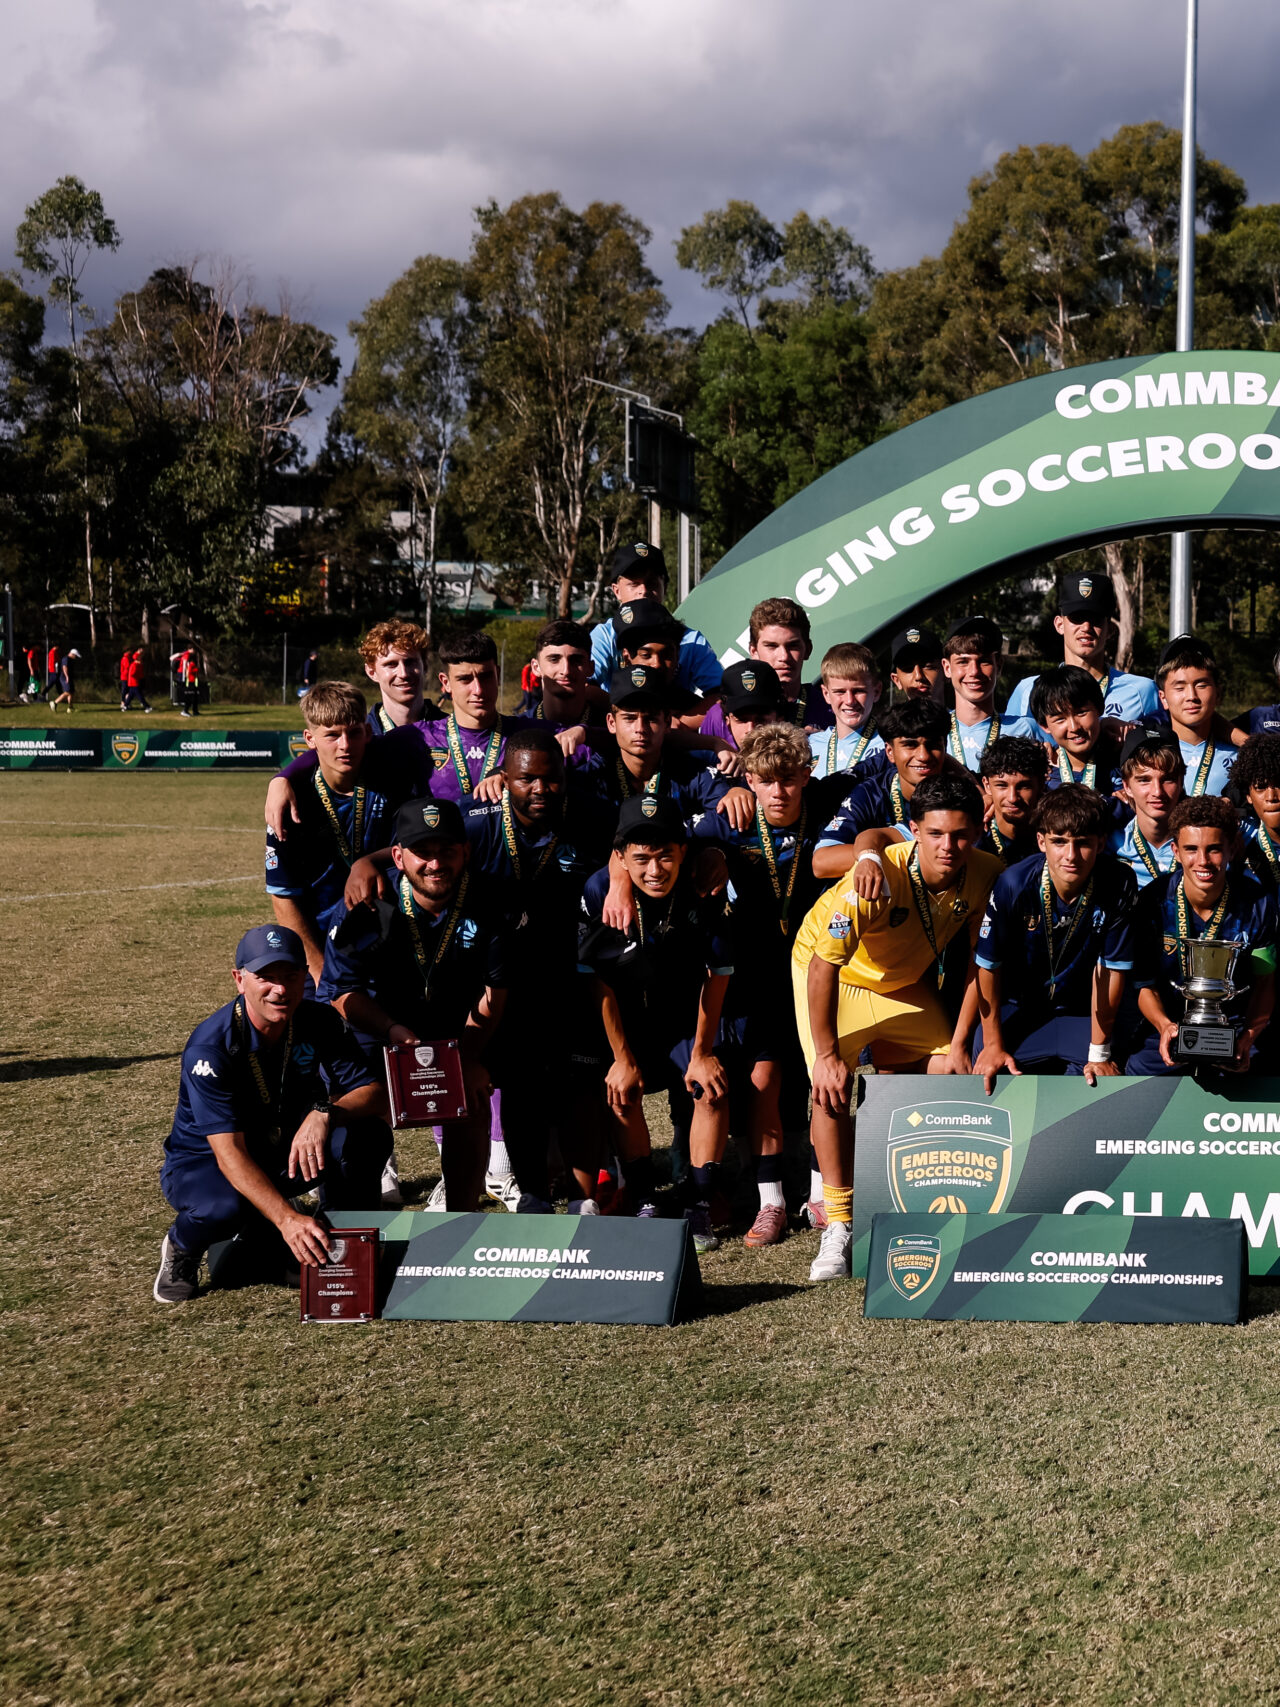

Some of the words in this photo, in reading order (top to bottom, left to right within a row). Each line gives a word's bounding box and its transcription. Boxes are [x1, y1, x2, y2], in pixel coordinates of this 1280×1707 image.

[180, 742, 236, 750] COMMBANK
[828, 727, 837, 776] AMPIONSH
[484, 750, 498, 778] BANK
[460, 779, 471, 794] 202
[1193, 766, 1208, 797] MBANK
[314, 775, 341, 834] AMPIONSHIPS
[501, 789, 519, 857] AMPIONSHIPS
[758, 803, 778, 876] HAMPIONSHIPS
[1142, 854, 1158, 880] BANK
[1214, 886, 1231, 923] EMERGIN
[248, 1052, 271, 1104] COMMBAN
[925, 1114, 992, 1126] CommBank
[1095, 1140, 1196, 1155] EMERGING
[901, 1150, 998, 1170] EMERGING
[904, 1166, 994, 1182] SOCCEROOS
[914, 1178, 982, 1188] CHAMPIONSHIPS
[474, 1248, 591, 1264] COMMBANK
[893, 1254, 934, 1264] EMERGING
[1030, 1252, 1147, 1268] COMMBANK
[396, 1266, 466, 1278] EMERGING
[468, 1266, 550, 1279] SOCCEROOS
[552, 1268, 665, 1282] CHAMPIONSHIPS
[954, 1272, 1025, 1283] EMERGING
[1026, 1272, 1108, 1284] SOCCEROOS
[1110, 1273, 1224, 1286] CHAMPIONSHIPS
